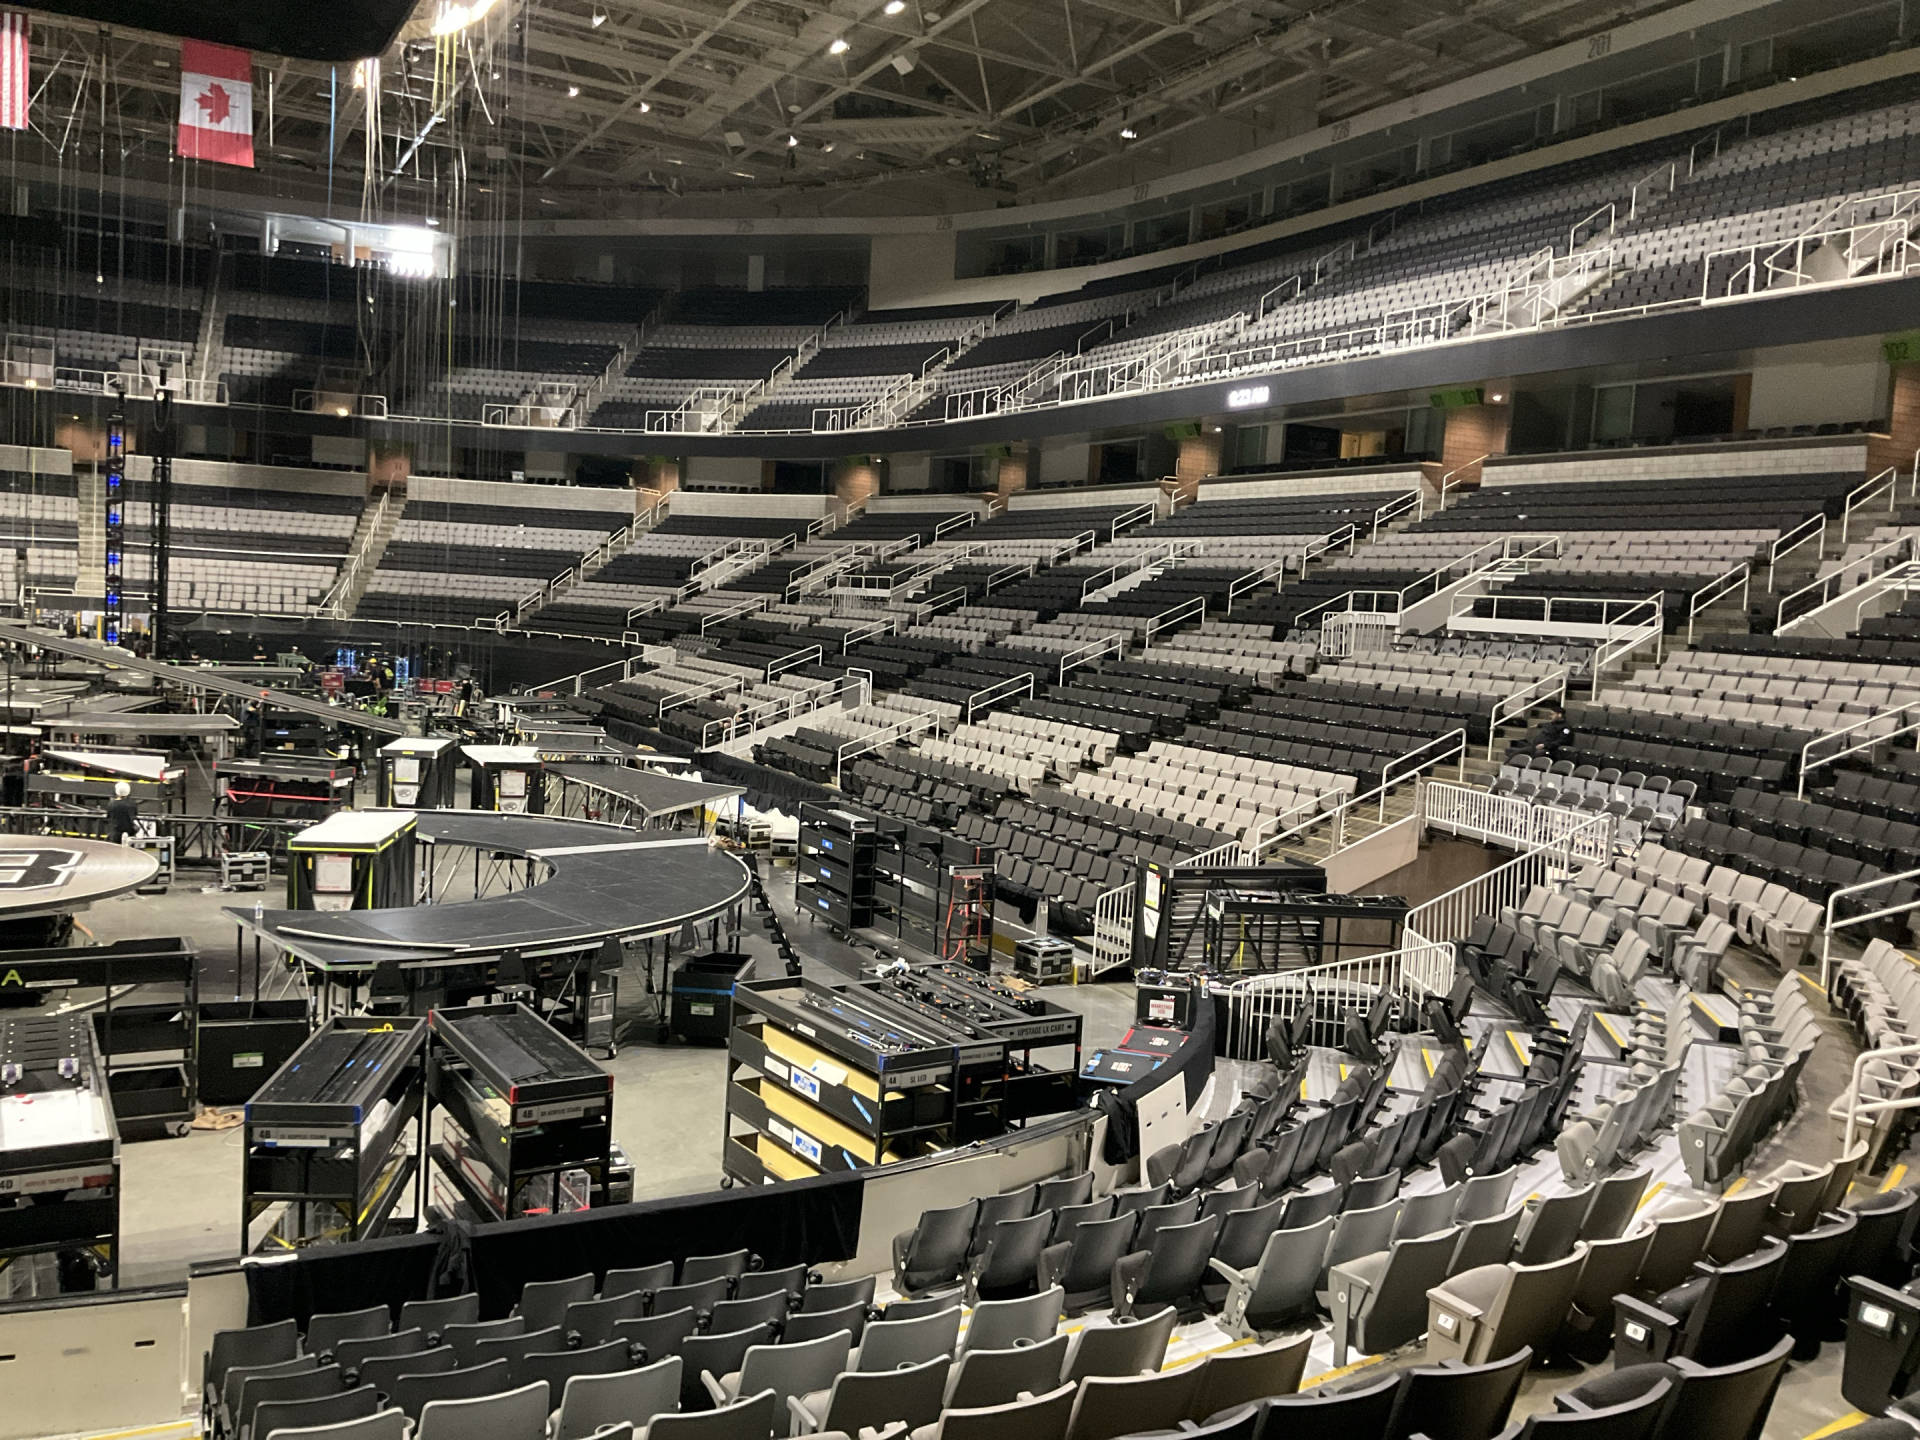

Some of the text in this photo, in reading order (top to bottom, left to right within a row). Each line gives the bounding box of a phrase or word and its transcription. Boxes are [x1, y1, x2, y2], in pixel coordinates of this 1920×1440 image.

[1587, 32, 1612, 59] 201
[936, 216, 954, 231] 226
[1883, 341, 1910, 361] 102
[1, 969, 24, 987] A
[1017, 1026, 1042, 1037] UPSTAGE
[1042, 1025, 1050, 1034] LX
[1050, 1023, 1065, 1033] CART
[889, 1074, 928, 1085] 4A SL LED
[523, 1109, 534, 1119] 4B
[259, 1129, 272, 1139] 4B
[0, 1178, 14, 1191] 4D
